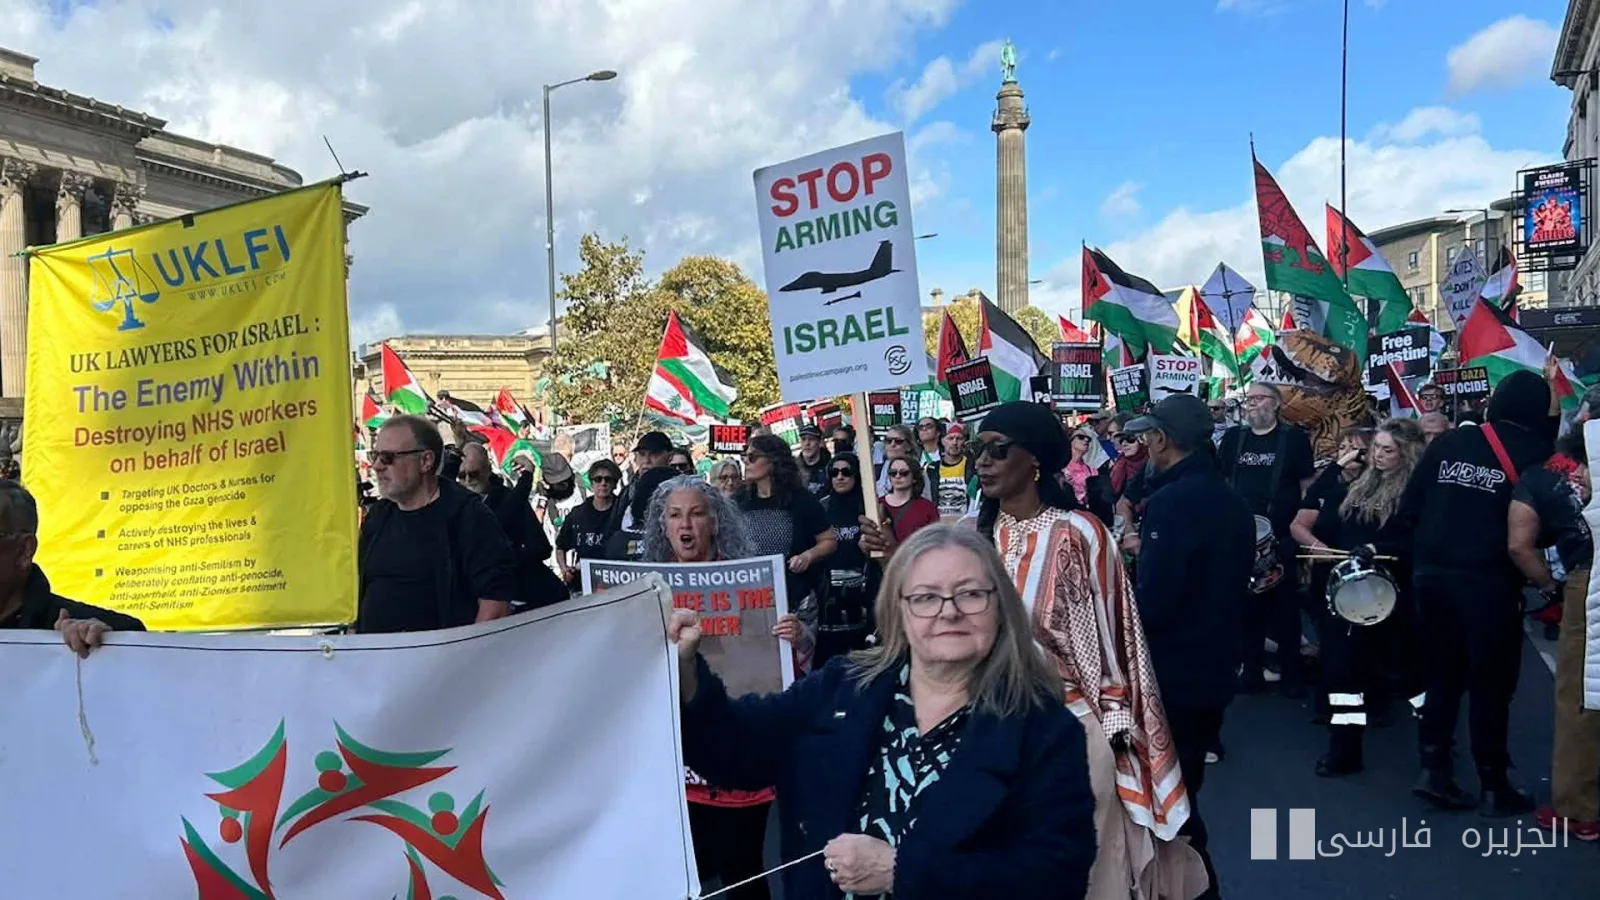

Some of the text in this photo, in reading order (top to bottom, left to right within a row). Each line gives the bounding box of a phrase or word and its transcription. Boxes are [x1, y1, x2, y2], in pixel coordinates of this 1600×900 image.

[770, 152, 893, 217] STOP
[774, 200, 898, 254] ARMING
[152, 224, 291, 287] UKLFI
[1452, 299, 1470, 311] KILL
[784, 306, 909, 355] ISRAEL
[70, 352, 101, 373] UK
[106, 338, 197, 370] LAWYERS
[200, 330, 239, 356] FOR
[242, 313, 308, 347] ISRAEL
[1381, 335, 1413, 351] Free
[1156, 359, 1197, 371] STOP
[1369, 346, 1428, 368] Palestine
[789, 363, 868, 383] palestinecampaign.org
[1060, 363, 1093, 378] ISRAEL
[1155, 372, 1196, 382] ARMING
[1460, 369, 1486, 380] GAZA
[73, 351, 320, 413] The Enemy Within
[957, 377, 988, 396] ISRAEL
[1443, 380, 1488, 395] ENOCIDE
[901, 391, 918, 401] UT
[901, 400, 918, 410] AR
[874, 404, 897, 415] ISRAEL
[901, 410, 917, 419] OT
[74, 399, 317, 447] Destroying NHS workers
[714, 425, 746, 443] FREE
[110, 430, 286, 474] on behalf of Israel
[122, 473, 276, 500] Targeting UK Doctors & Nurses for
[119, 490, 246, 514] opposing the Gaza genocide
[118, 516, 257, 539] Actively destroying the lives &
[117, 530, 251, 551] careers of NHS professionals
[115, 557, 257, 578] Weaponising anti-Semitism by
[114, 577, 169, 589] deliberately
[171, 574, 218, 586] conflating
[668, 572, 684, 586] IS
[179, 585, 238, 597] anti-Zionism
[240, 581, 287, 592] sentiment
[709, 590, 731, 611] IS
[736, 585, 775, 610] THE
[126, 600, 194, 610] anti-Semitism
